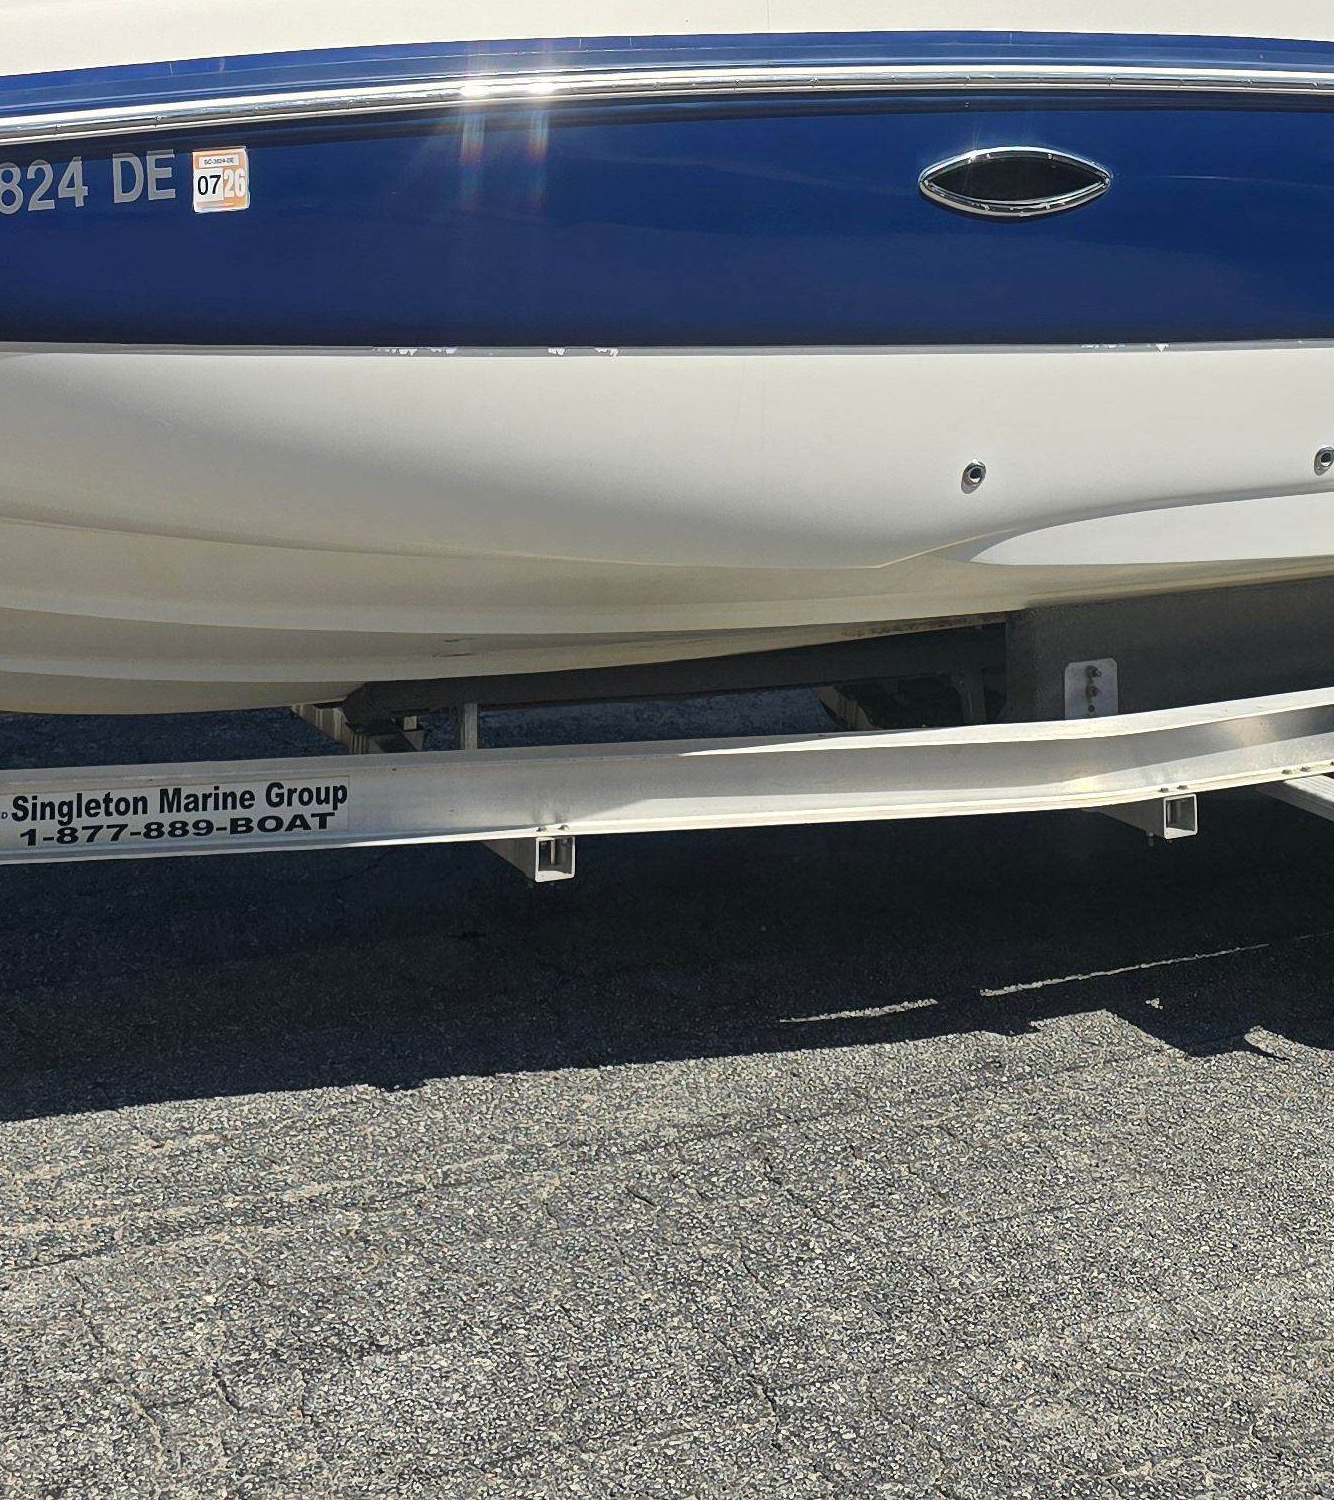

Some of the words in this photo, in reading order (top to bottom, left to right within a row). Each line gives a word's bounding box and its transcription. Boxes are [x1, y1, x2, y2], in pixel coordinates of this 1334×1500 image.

[112, 149, 176, 204] DE
[197, 174, 222, 195] 07
[223, 168, 246, 198] 26
[11, 793, 148, 826] Singleton
[159, 786, 256, 814] Marine
[265, 782, 348, 809] Group
[20, 811, 336, 847] 1-877-889-BOAT
